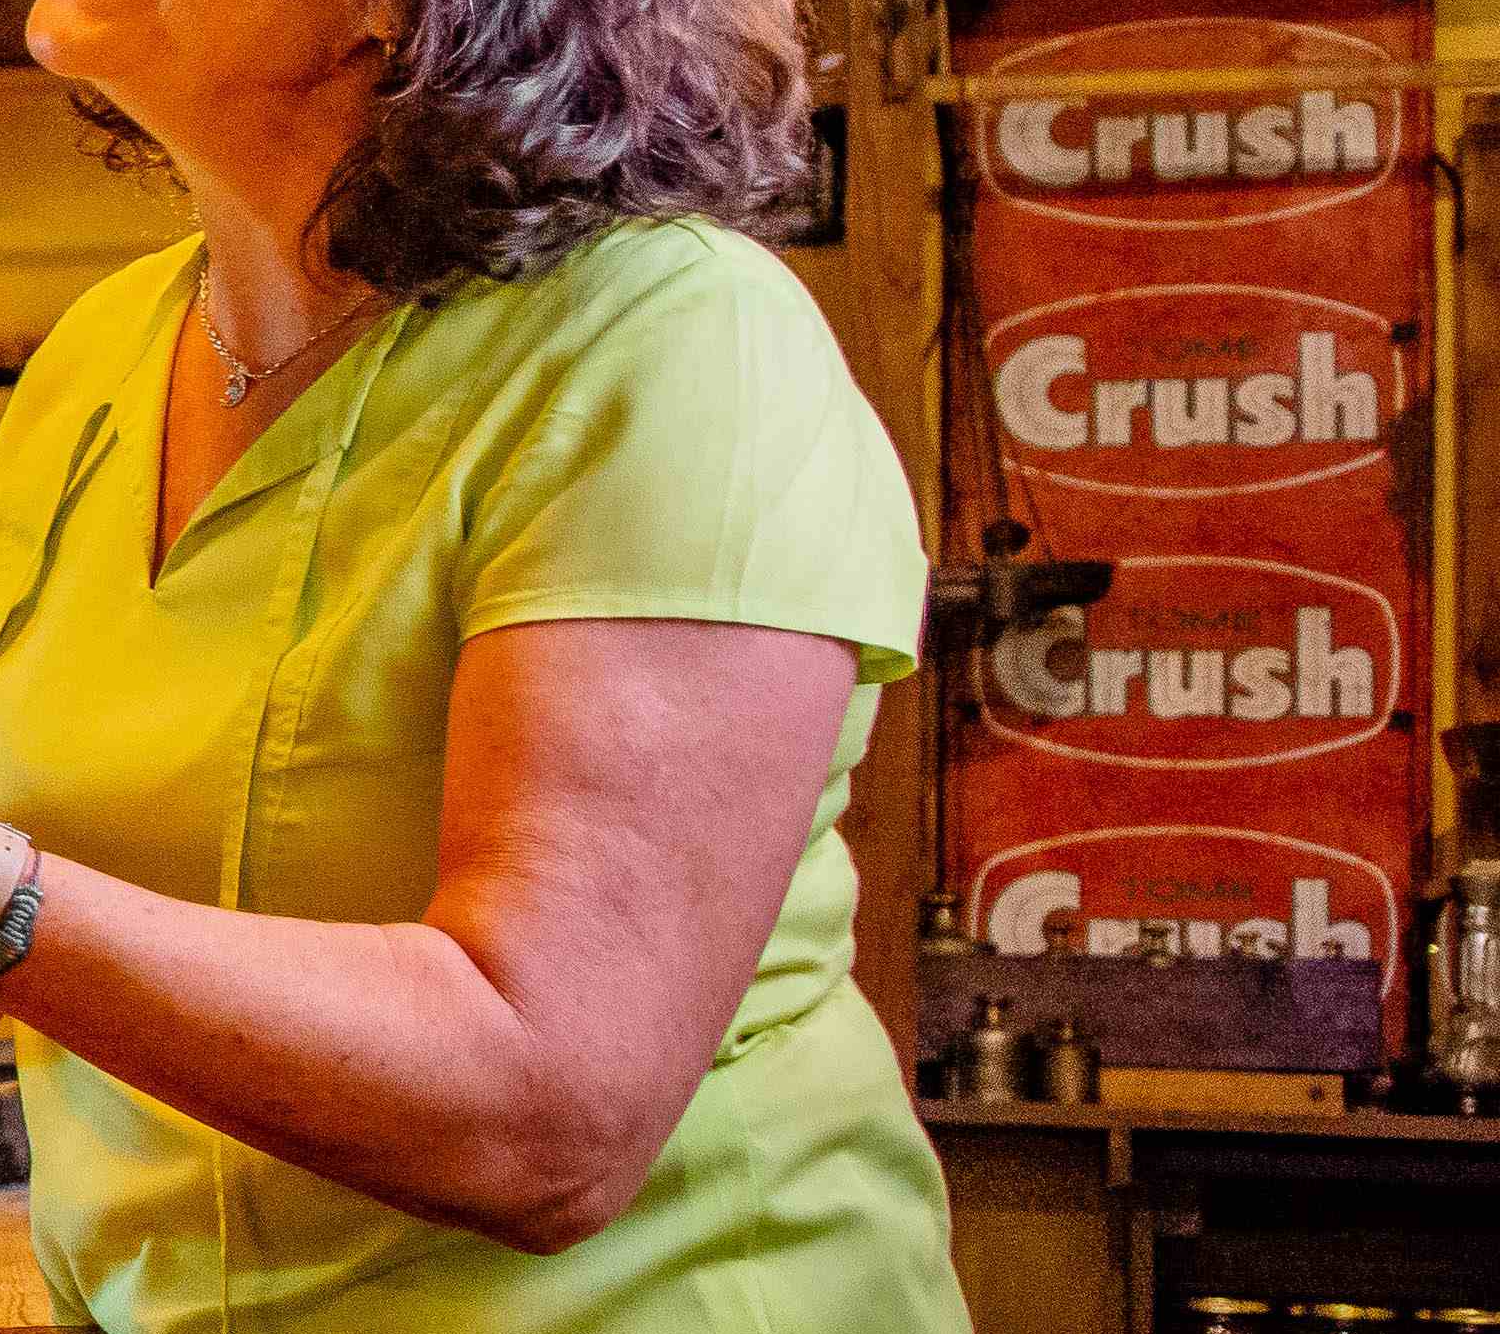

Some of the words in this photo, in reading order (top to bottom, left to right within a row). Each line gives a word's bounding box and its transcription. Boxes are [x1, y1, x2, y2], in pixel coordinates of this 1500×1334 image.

[998, 91, 1377, 187] Crush
[996, 331, 1378, 450] Crush
[993, 605, 1375, 721] Crush
